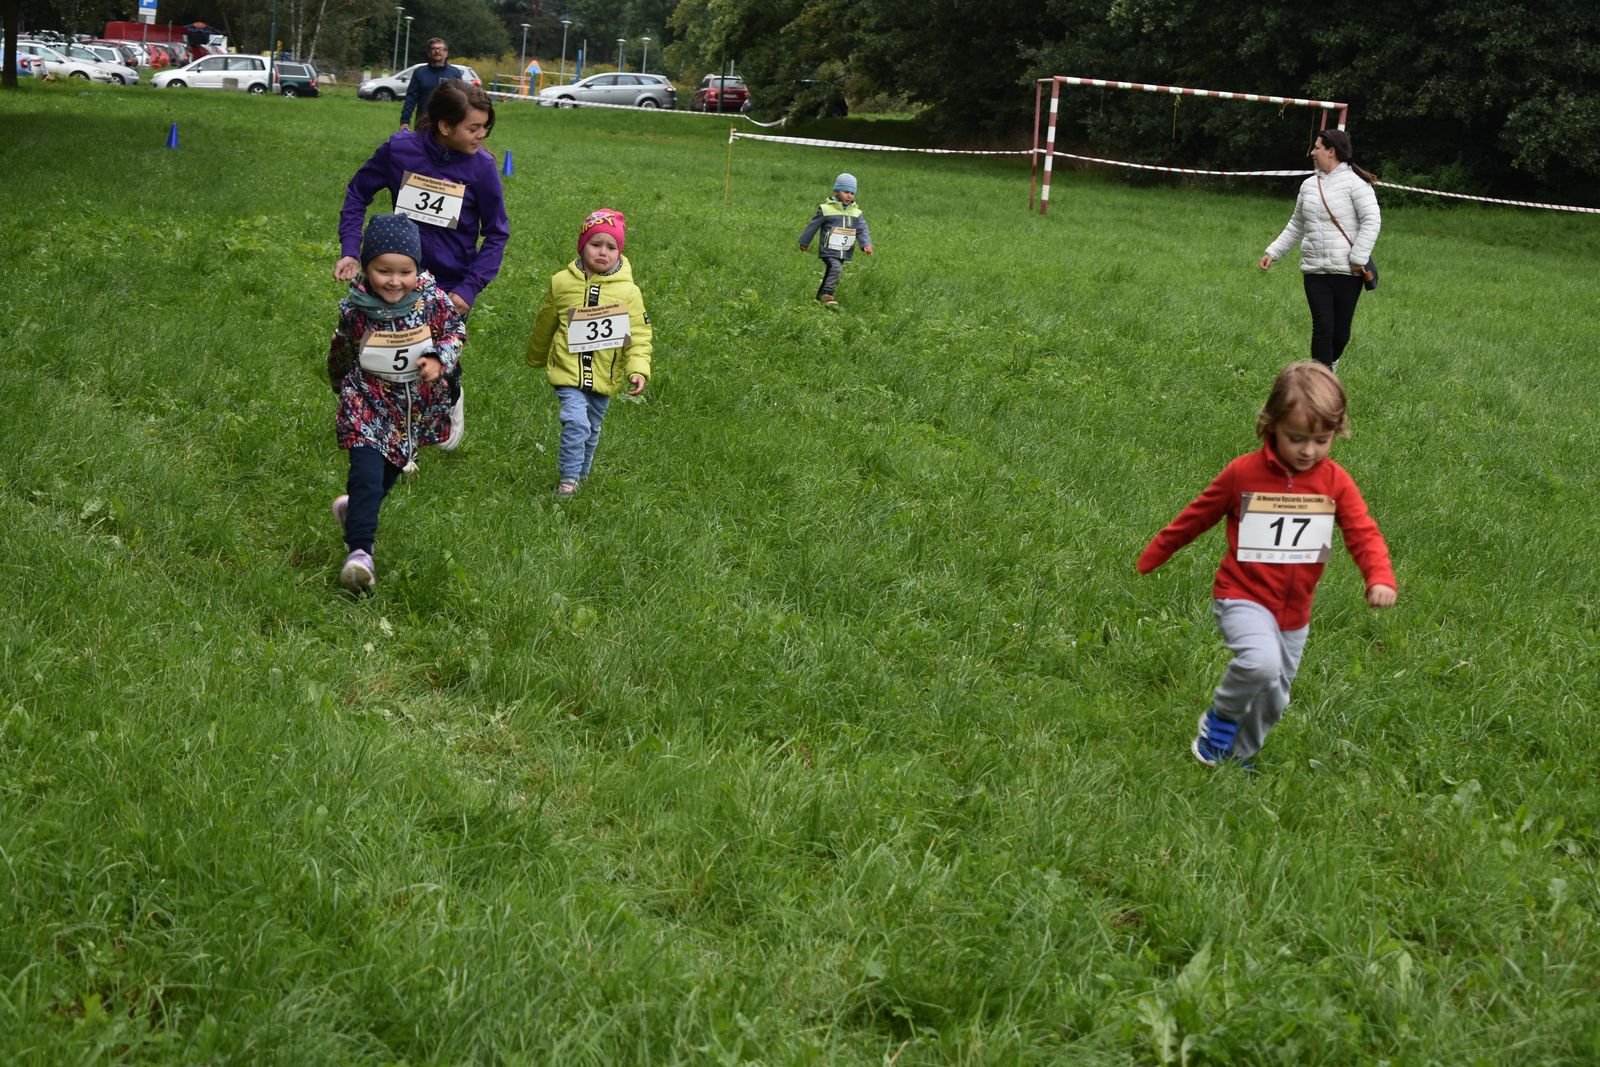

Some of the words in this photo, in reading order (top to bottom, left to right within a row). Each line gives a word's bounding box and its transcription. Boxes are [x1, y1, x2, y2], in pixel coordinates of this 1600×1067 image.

[415, 191, 445, 215] 34
[841, 235, 849, 246] 3
[586, 318, 613, 341] 33
[392, 348, 409, 372] 5
[1269, 516, 1312, 547] 17
